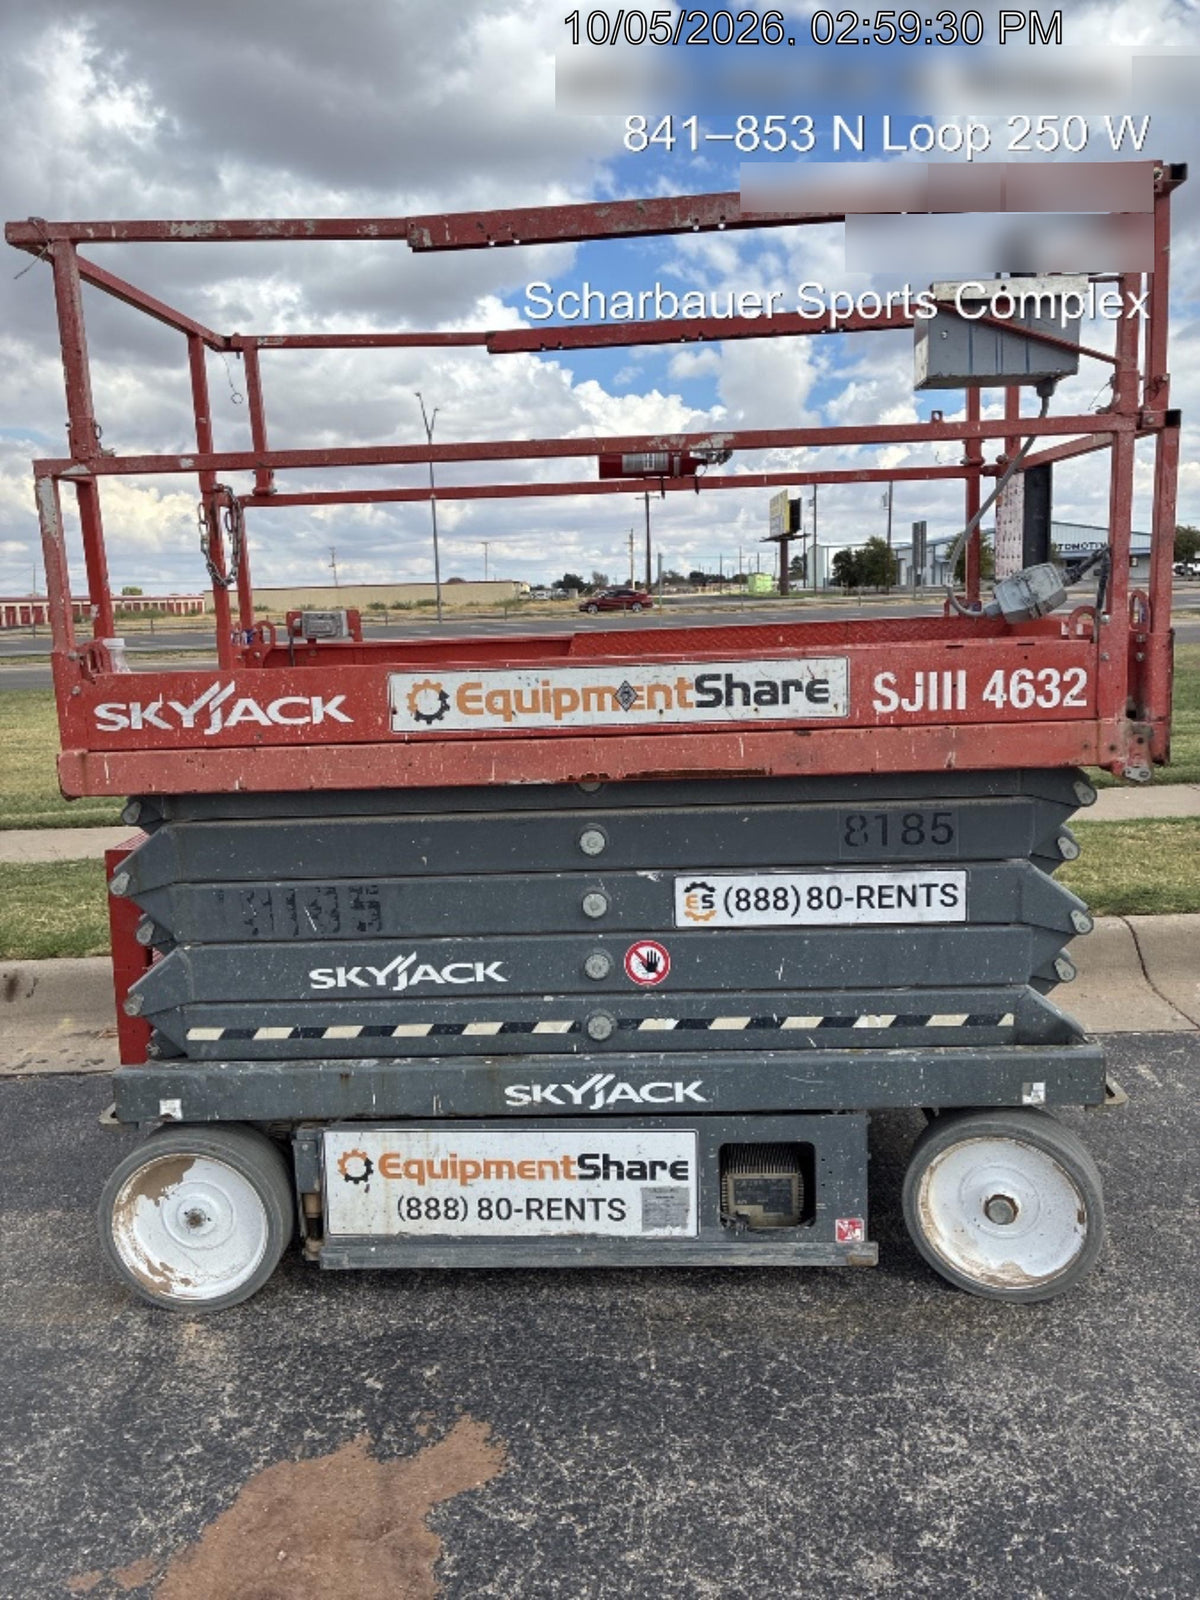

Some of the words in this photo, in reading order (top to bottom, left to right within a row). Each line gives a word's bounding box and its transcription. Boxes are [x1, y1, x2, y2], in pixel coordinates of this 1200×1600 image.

[982, 667, 1088, 710] 4632
[94, 680, 354, 735] SKYJACK
[844, 811, 954, 848] 8185
[723, 885, 801, 918] (888)
[806, 883, 959, 911] 80-RENTS
[308, 952, 509, 991] SKYJACK
[504, 1073, 709, 1109] SKYJACK
[378, 1152, 690, 1186] EquipmentShare
[396, 1194, 470, 1224] (888)
[477, 1195, 627, 1223] 80-RENTS
